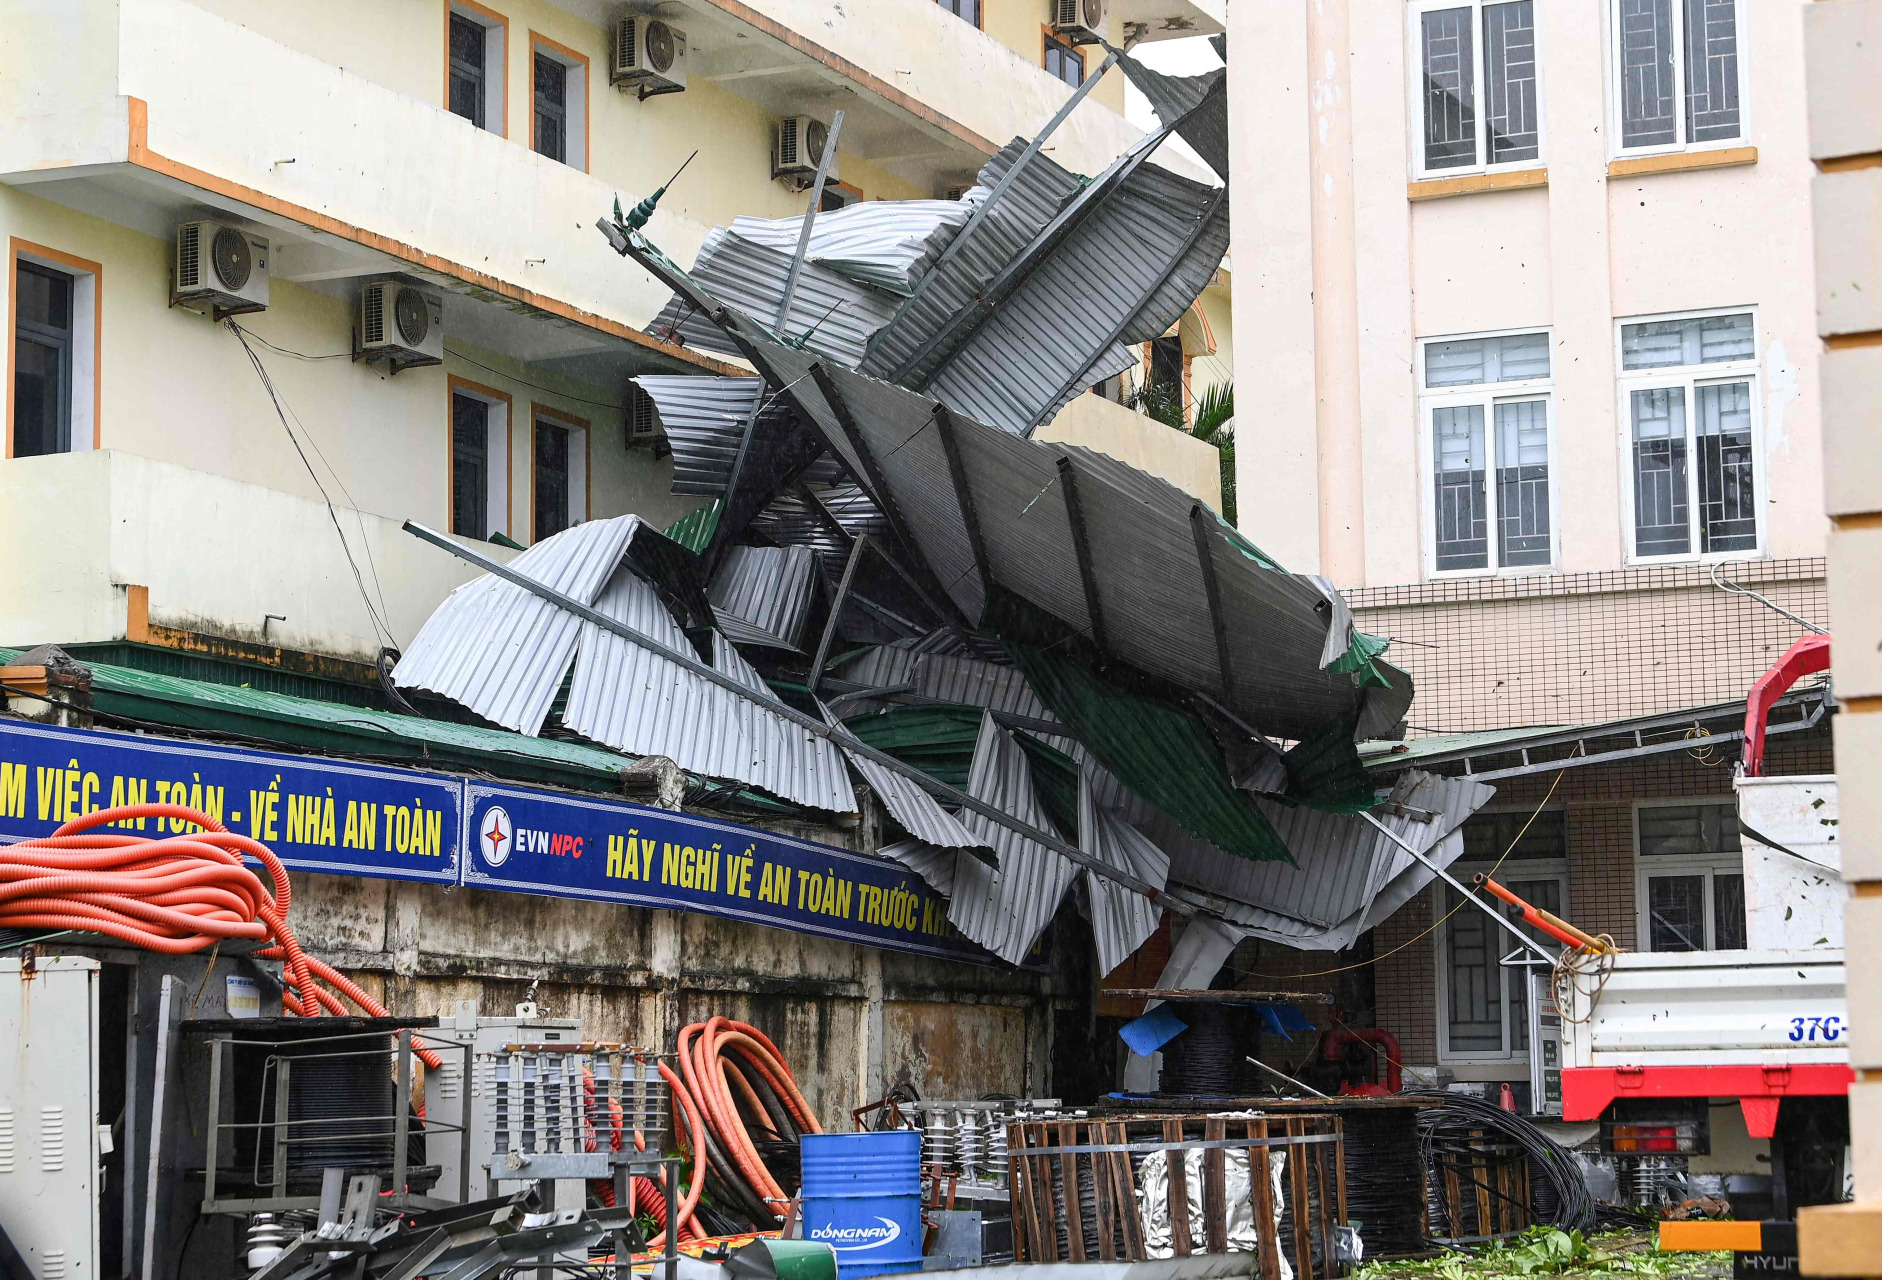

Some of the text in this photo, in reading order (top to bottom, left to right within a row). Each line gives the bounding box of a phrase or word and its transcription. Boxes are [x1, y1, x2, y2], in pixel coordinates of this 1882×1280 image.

[107, 775, 147, 830] AN
[155, 773, 224, 834] TOÀN
[250, 773, 282, 842] VỀ
[286, 787, 337, 848] NHÀ
[343, 802, 377, 850] AN
[384, 797, 442, 857] TOÀN
[607, 829, 656, 882] HÃY
[662, 843, 722, 892] NGHĨ
[727, 843, 756, 898] VỀ
[758, 861, 791, 906] AN
[797, 867, 852, 919] TOÀN
[858, 881, 919, 931] TRƯỚC
